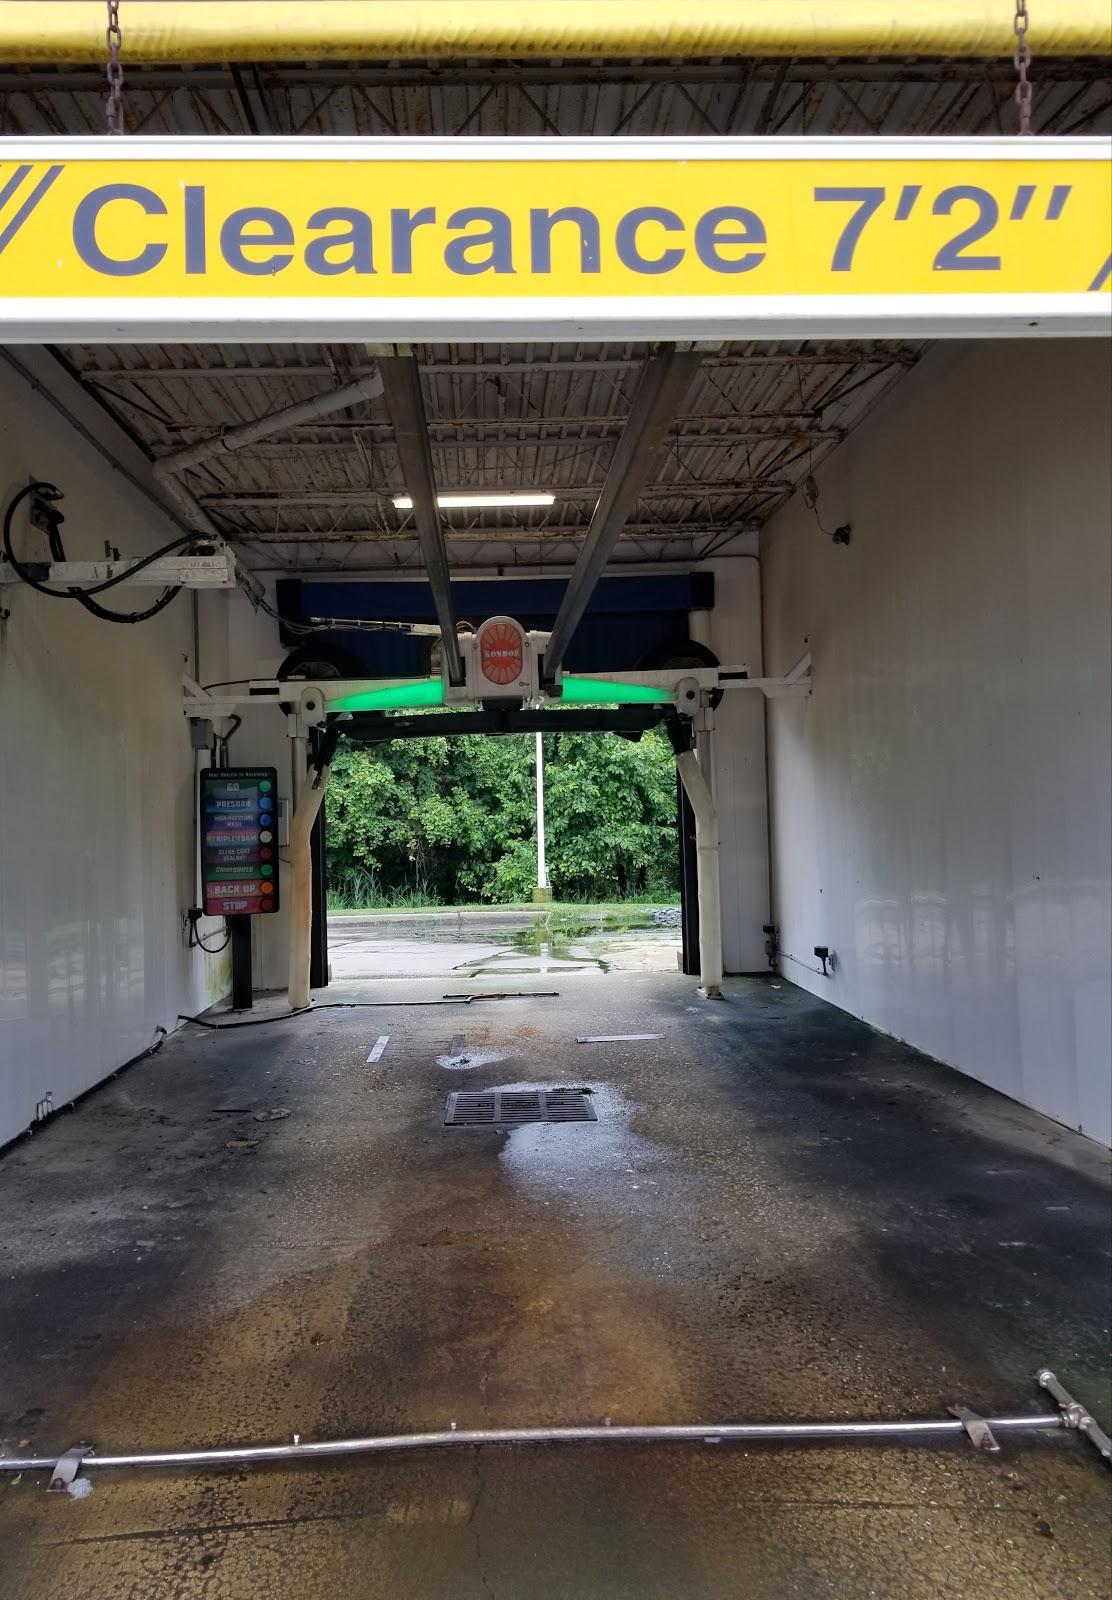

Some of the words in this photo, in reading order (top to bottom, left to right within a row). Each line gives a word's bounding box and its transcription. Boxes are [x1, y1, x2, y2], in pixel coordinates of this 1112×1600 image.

[72, 182, 767, 277] Clearance
[485, 649, 520, 657] KONDOR
[214, 885, 240, 895] BACK
[243, 884, 256, 893] UP
[223, 901, 248, 910] STOP
